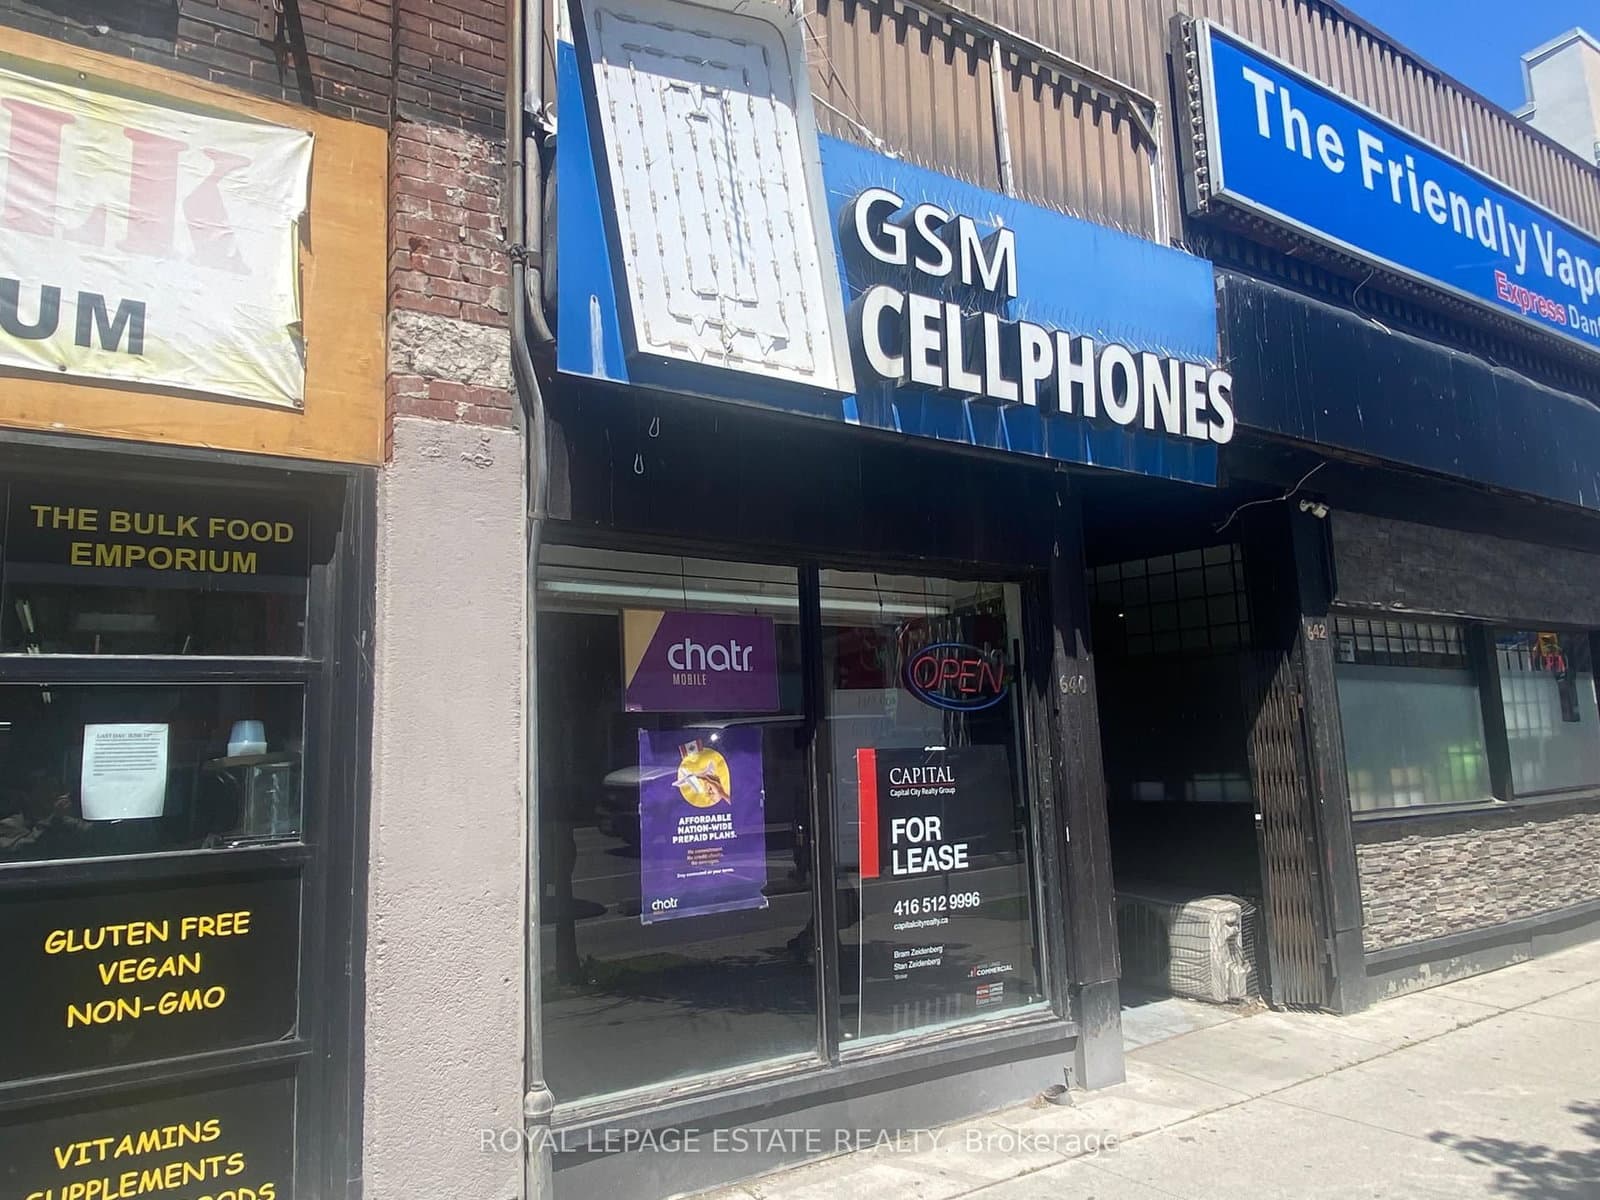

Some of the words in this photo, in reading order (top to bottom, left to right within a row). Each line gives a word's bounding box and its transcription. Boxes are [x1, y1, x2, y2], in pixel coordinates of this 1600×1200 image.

[1242, 66, 1344, 174] The
[1357, 128, 1527, 275] Friendly
[855, 187, 1017, 298] GSM
[1494, 268, 1567, 326] Express
[1567, 303, 1600, 338] Dan
[861, 285, 1234, 445] CELLPHONES
[30, 505, 99, 531] THE
[109, 510, 199, 538] BULK
[208, 517, 294, 543] FOOD
[70, 542, 257, 574] EMPORIUM
[1307, 623, 1327, 641] 642
[667, 638, 753, 671] chatr
[672, 673, 707, 686] MOBILE
[913, 656, 1004, 693] OPEN
[1059, 674, 1088, 695] 640
[889, 766, 955, 785] CAPITAL
[889, 788, 910, 797] Capital
[910, 788, 921, 798] City
[921, 787, 938, 796] Realty
[938, 786, 956, 795] Group
[677, 822, 733, 835] NATION-WIDE
[679, 813, 732, 826] AFFORDABLE
[891, 816, 942, 844] FOR
[672, 833, 708, 844] PREPAID
[709, 830, 738, 841] PLANS.
[892, 843, 969, 876] LEASE
[893, 898, 920, 916] 416
[922, 895, 947, 913] 512
[949, 891, 980, 910] 9996
[44, 921, 169, 955] GLUTEN
[181, 911, 251, 940] FREE
[98, 952, 201, 985] VEGAN
[67, 986, 225, 1028] NON-GMO
[54, 1119, 221, 1169] VITAMINS
